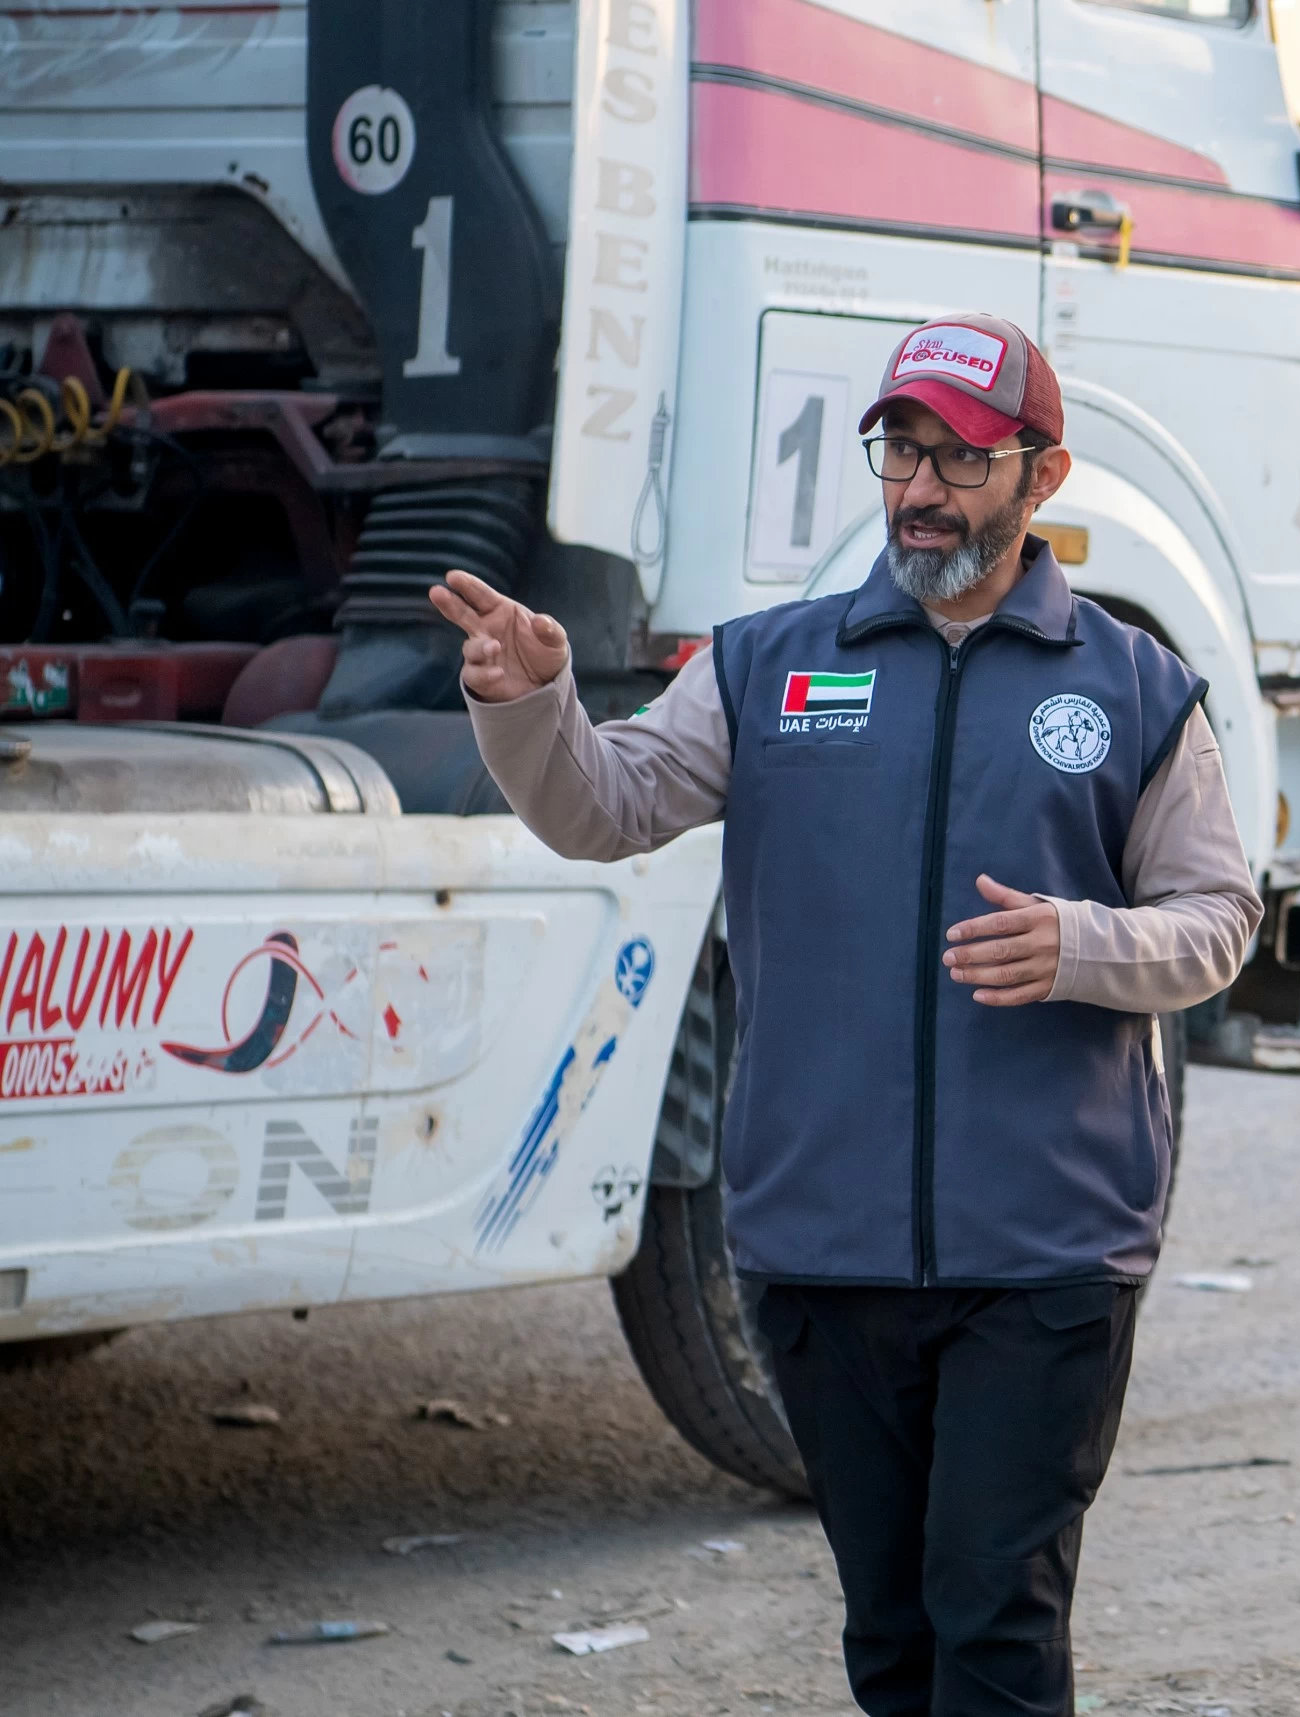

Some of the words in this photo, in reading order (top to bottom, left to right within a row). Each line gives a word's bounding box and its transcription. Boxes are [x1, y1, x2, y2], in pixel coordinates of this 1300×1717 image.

[348, 116, 401, 165] 60
[403, 196, 461, 378] 1
[581, 157, 657, 442] BENZ
[900, 348, 994, 373] FOCUSED
[777, 396, 825, 547] 1
[779, 718, 811, 733] UAE
[815, 715, 869, 733] الإمارات
[1033, 726, 1053, 760] OPERATION
[1053, 758, 1093, 769] CHIVALROUS
[1093, 742, 1107, 763] KNIGHT
